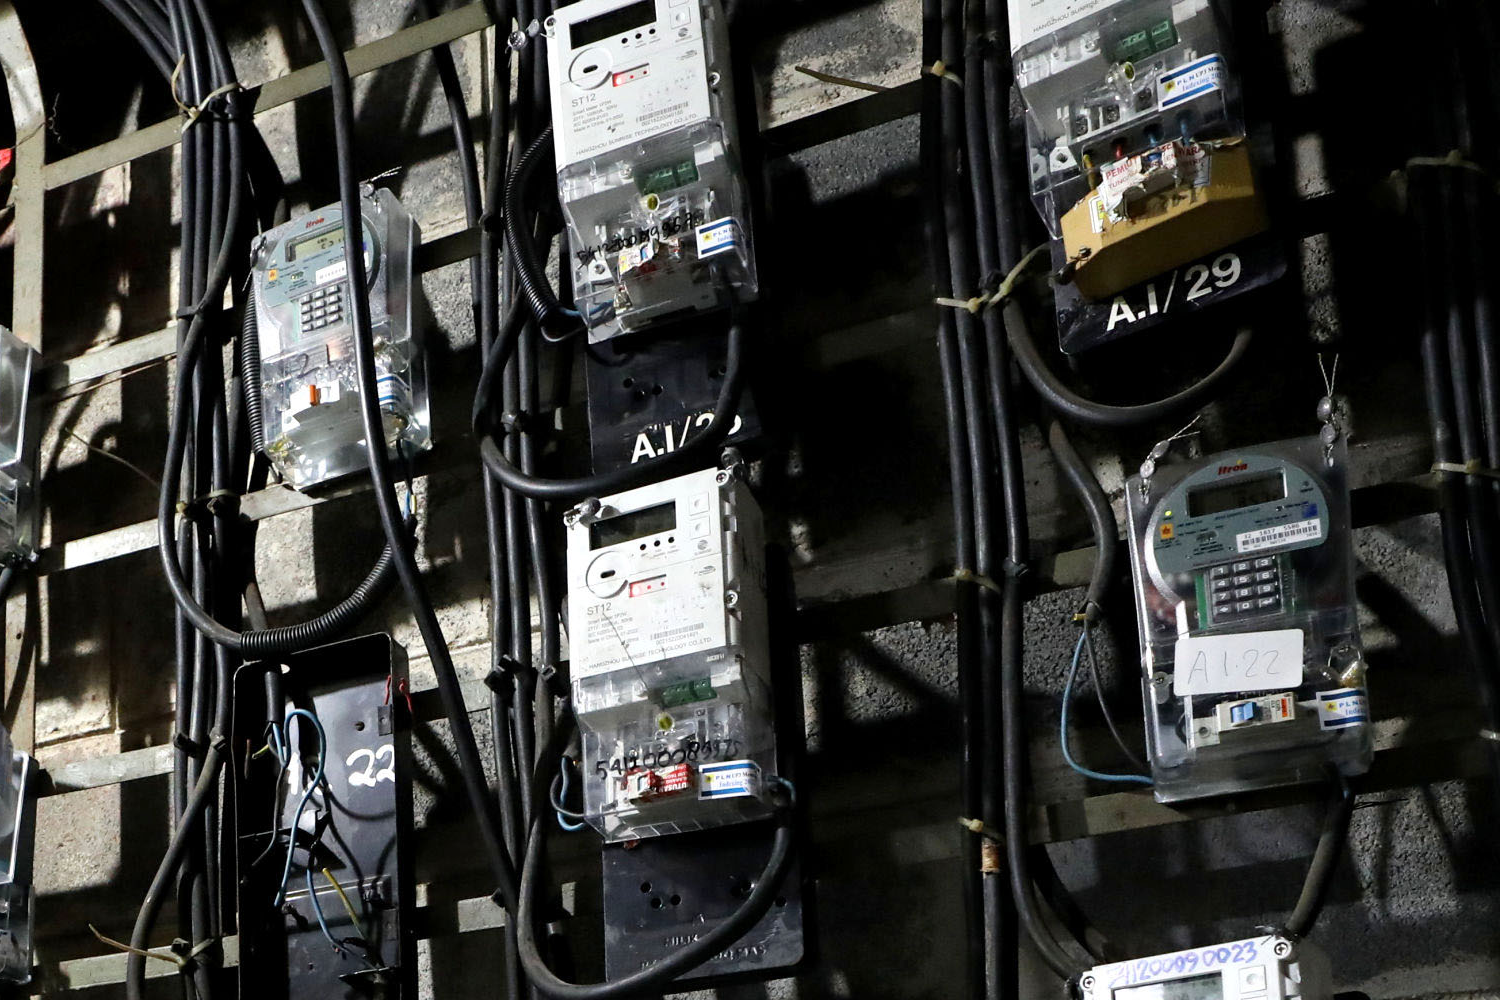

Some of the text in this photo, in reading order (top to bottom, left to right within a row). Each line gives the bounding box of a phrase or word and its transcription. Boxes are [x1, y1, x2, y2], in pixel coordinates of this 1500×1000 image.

[572, 93, 596, 108] ST12
[1106, 252, 1242, 332] A.I/29
[587, 602, 612, 616] ST12
